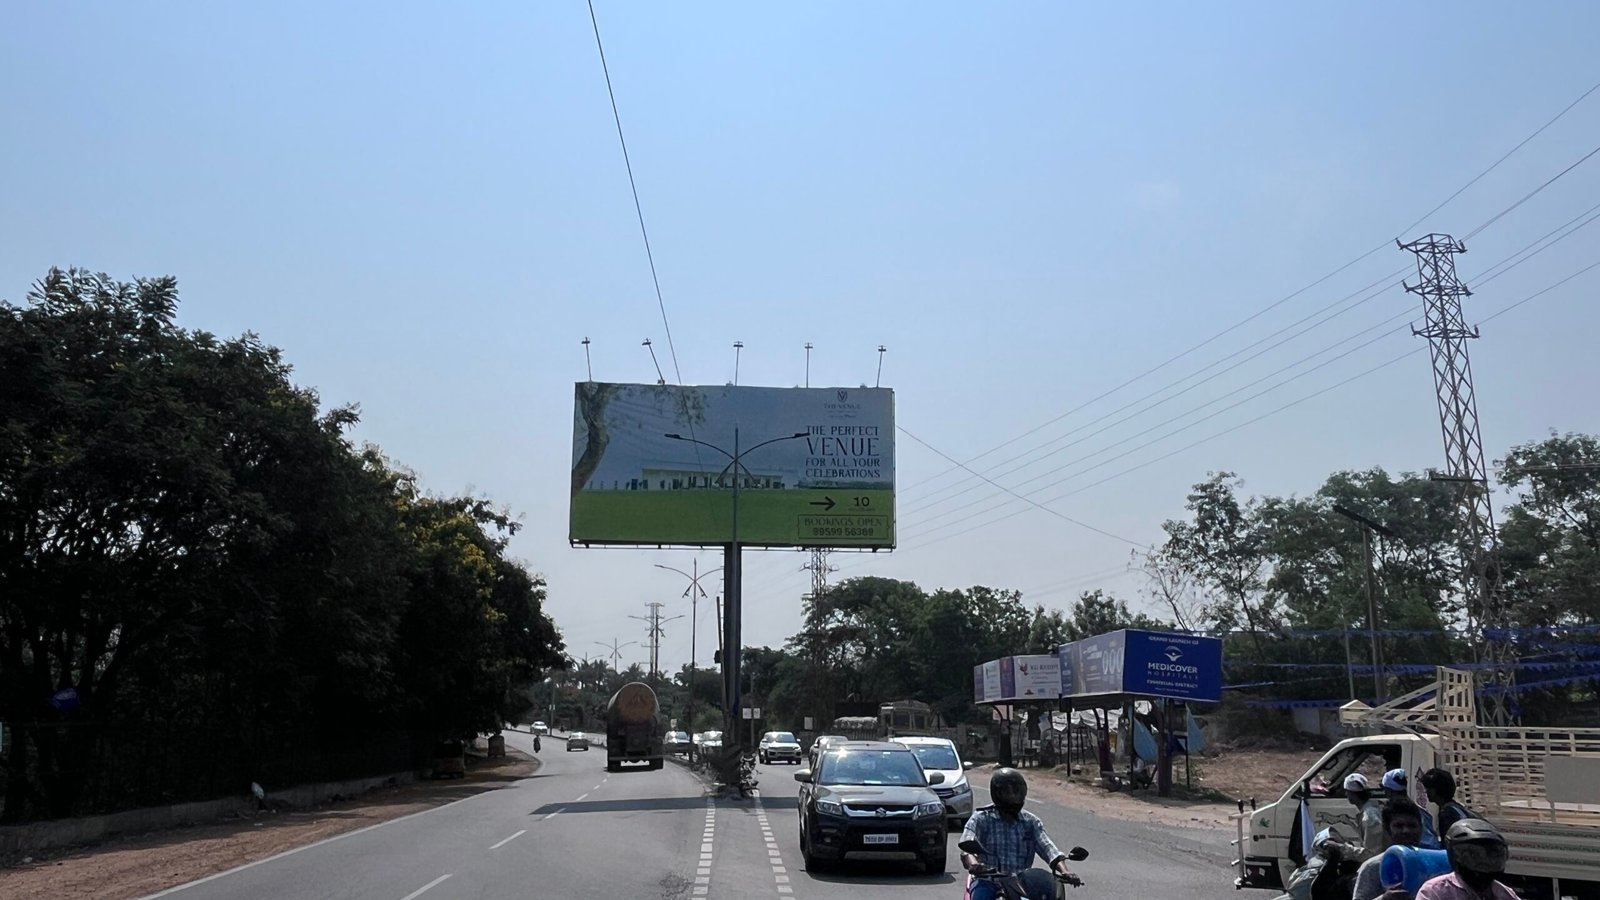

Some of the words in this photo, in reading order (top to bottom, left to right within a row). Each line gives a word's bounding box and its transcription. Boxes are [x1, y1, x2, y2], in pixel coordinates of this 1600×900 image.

[806, 426, 826, 435] THE
[831, 426, 879, 436] PERFECT
[806, 437, 879, 456] VENUE
[806, 458, 826, 467] FOR
[830, 458, 849, 467] ALL
[850, 458, 880, 467] YOUR
[806, 468, 880, 478] CELEBRATIONS
[854, 496, 870, 506] 10
[804, 517, 853, 526] BOOKINGS
[858, 518, 881, 526] OPEN
[1148, 662, 1198, 673] MEDICOVER
